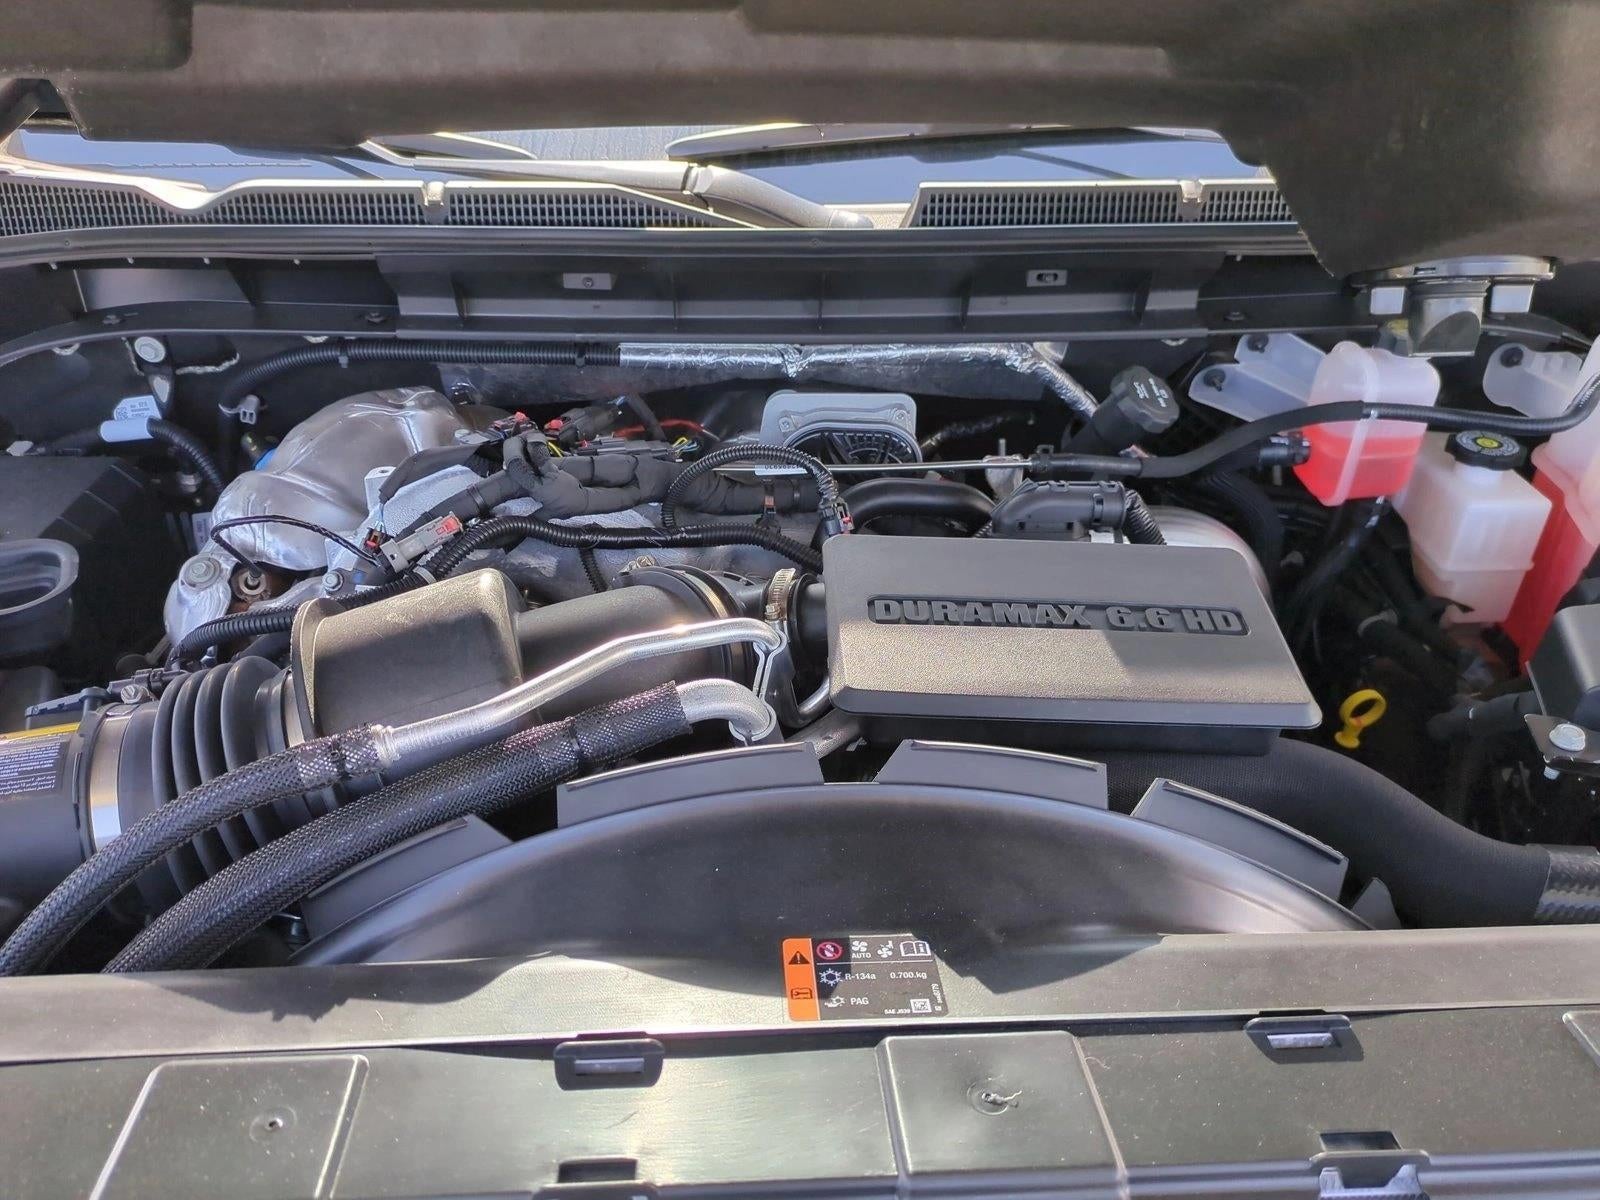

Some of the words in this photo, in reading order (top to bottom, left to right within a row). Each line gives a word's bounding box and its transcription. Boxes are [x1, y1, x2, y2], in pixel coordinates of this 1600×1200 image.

[874, 599, 1092, 628] DURAMAX
[1104, 605, 1174, 632] 6.6
[1180, 608, 1243, 633] HD
[845, 972, 876, 980] R-134a
[850, 997, 870, 1006] PAG
